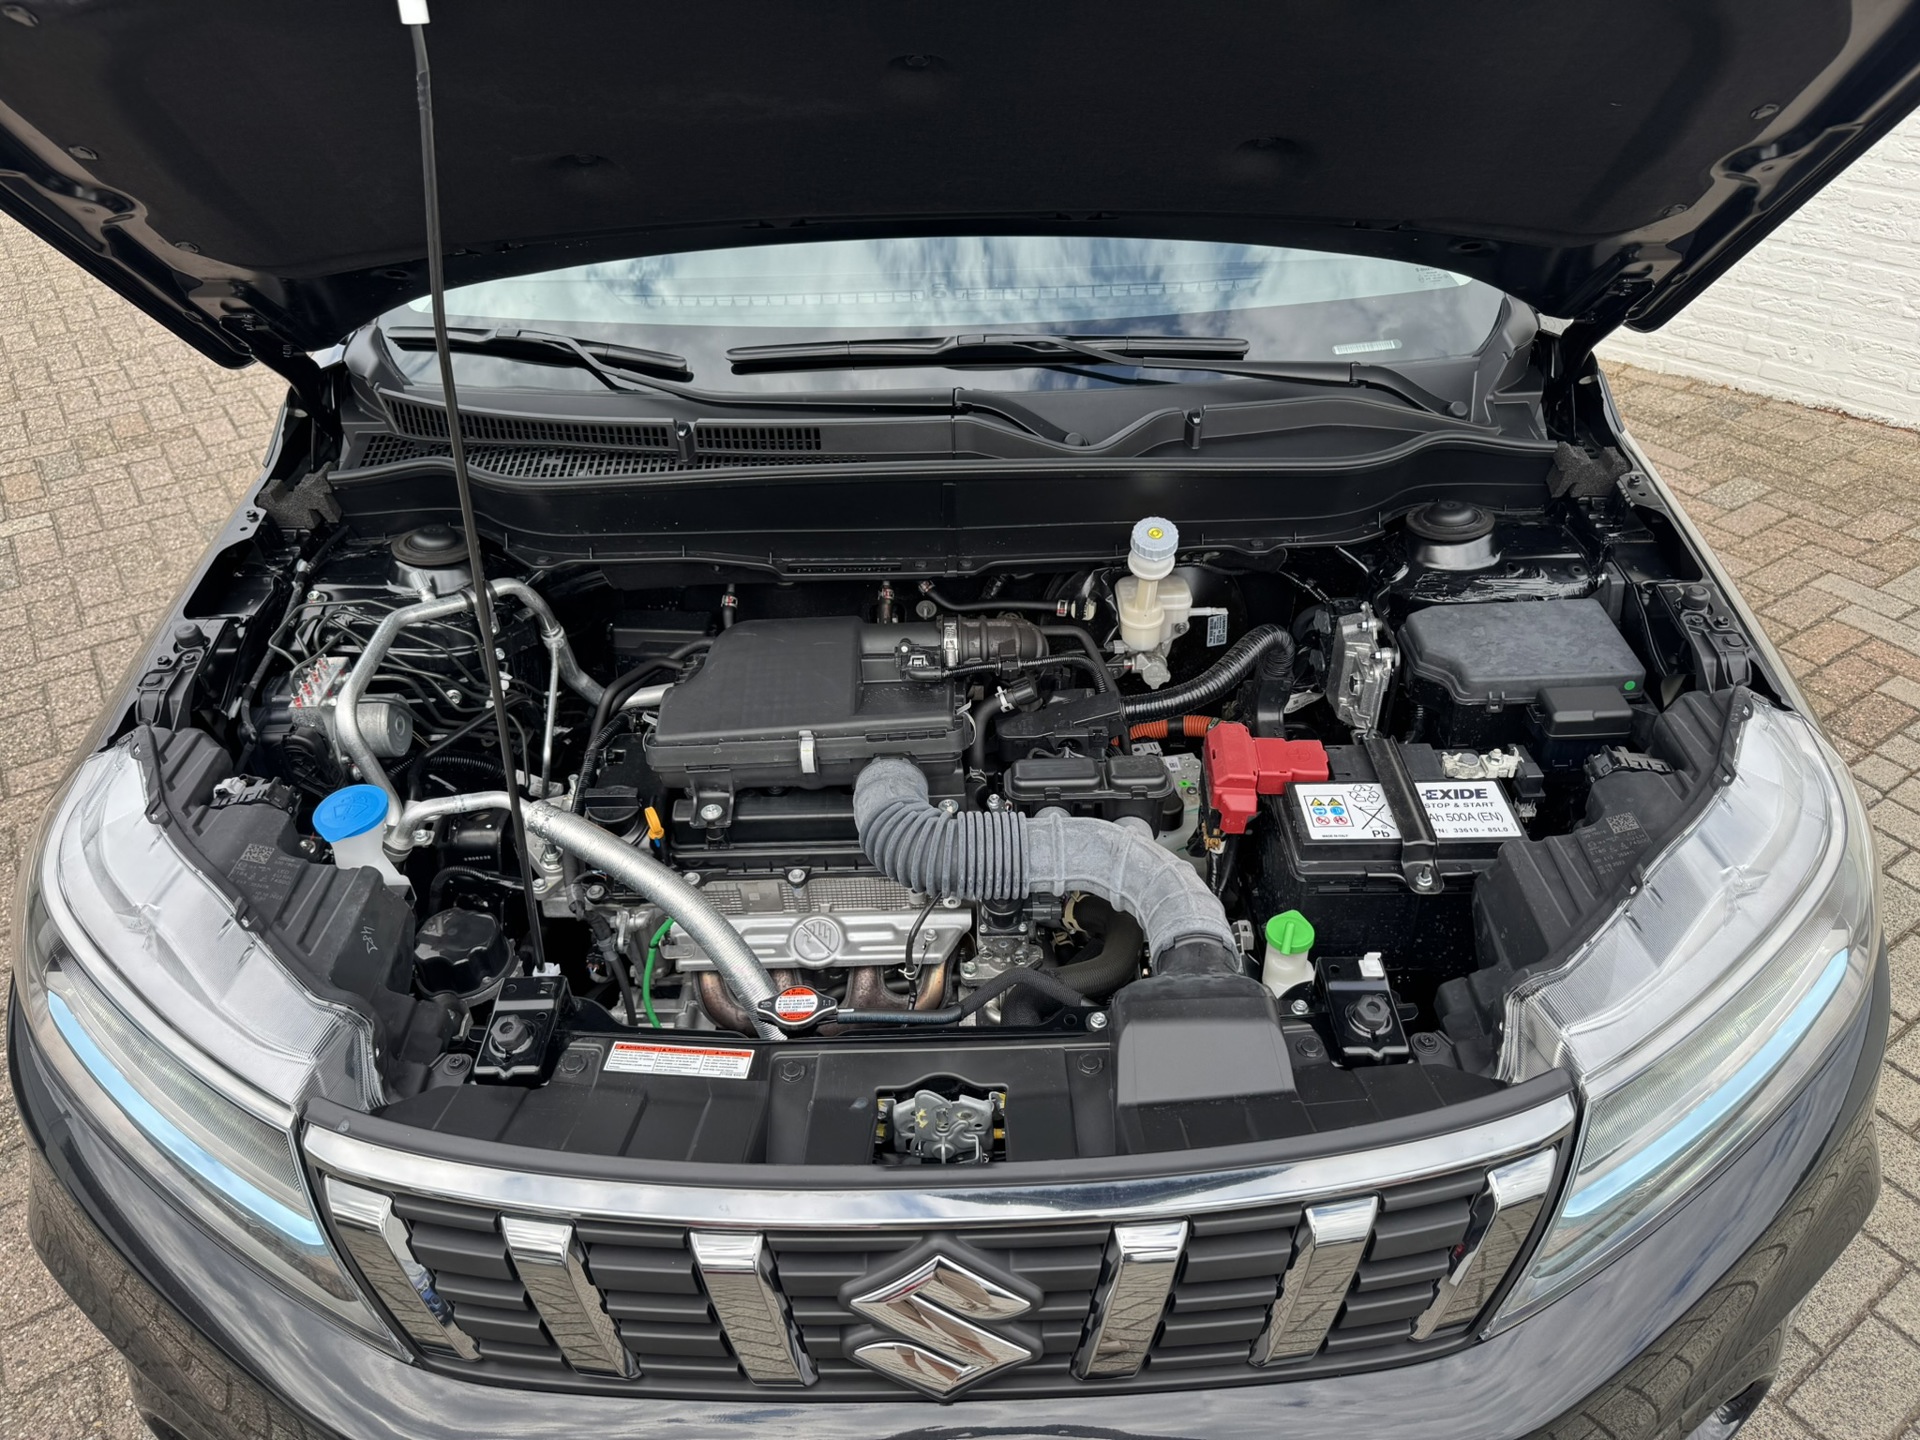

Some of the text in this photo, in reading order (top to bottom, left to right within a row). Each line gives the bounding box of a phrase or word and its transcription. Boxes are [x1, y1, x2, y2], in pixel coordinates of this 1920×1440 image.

[1422, 789, 1488, 800] EXIDE
[1446, 812, 1477, 821] 500A
[1477, 812, 1504, 823] (EN)
